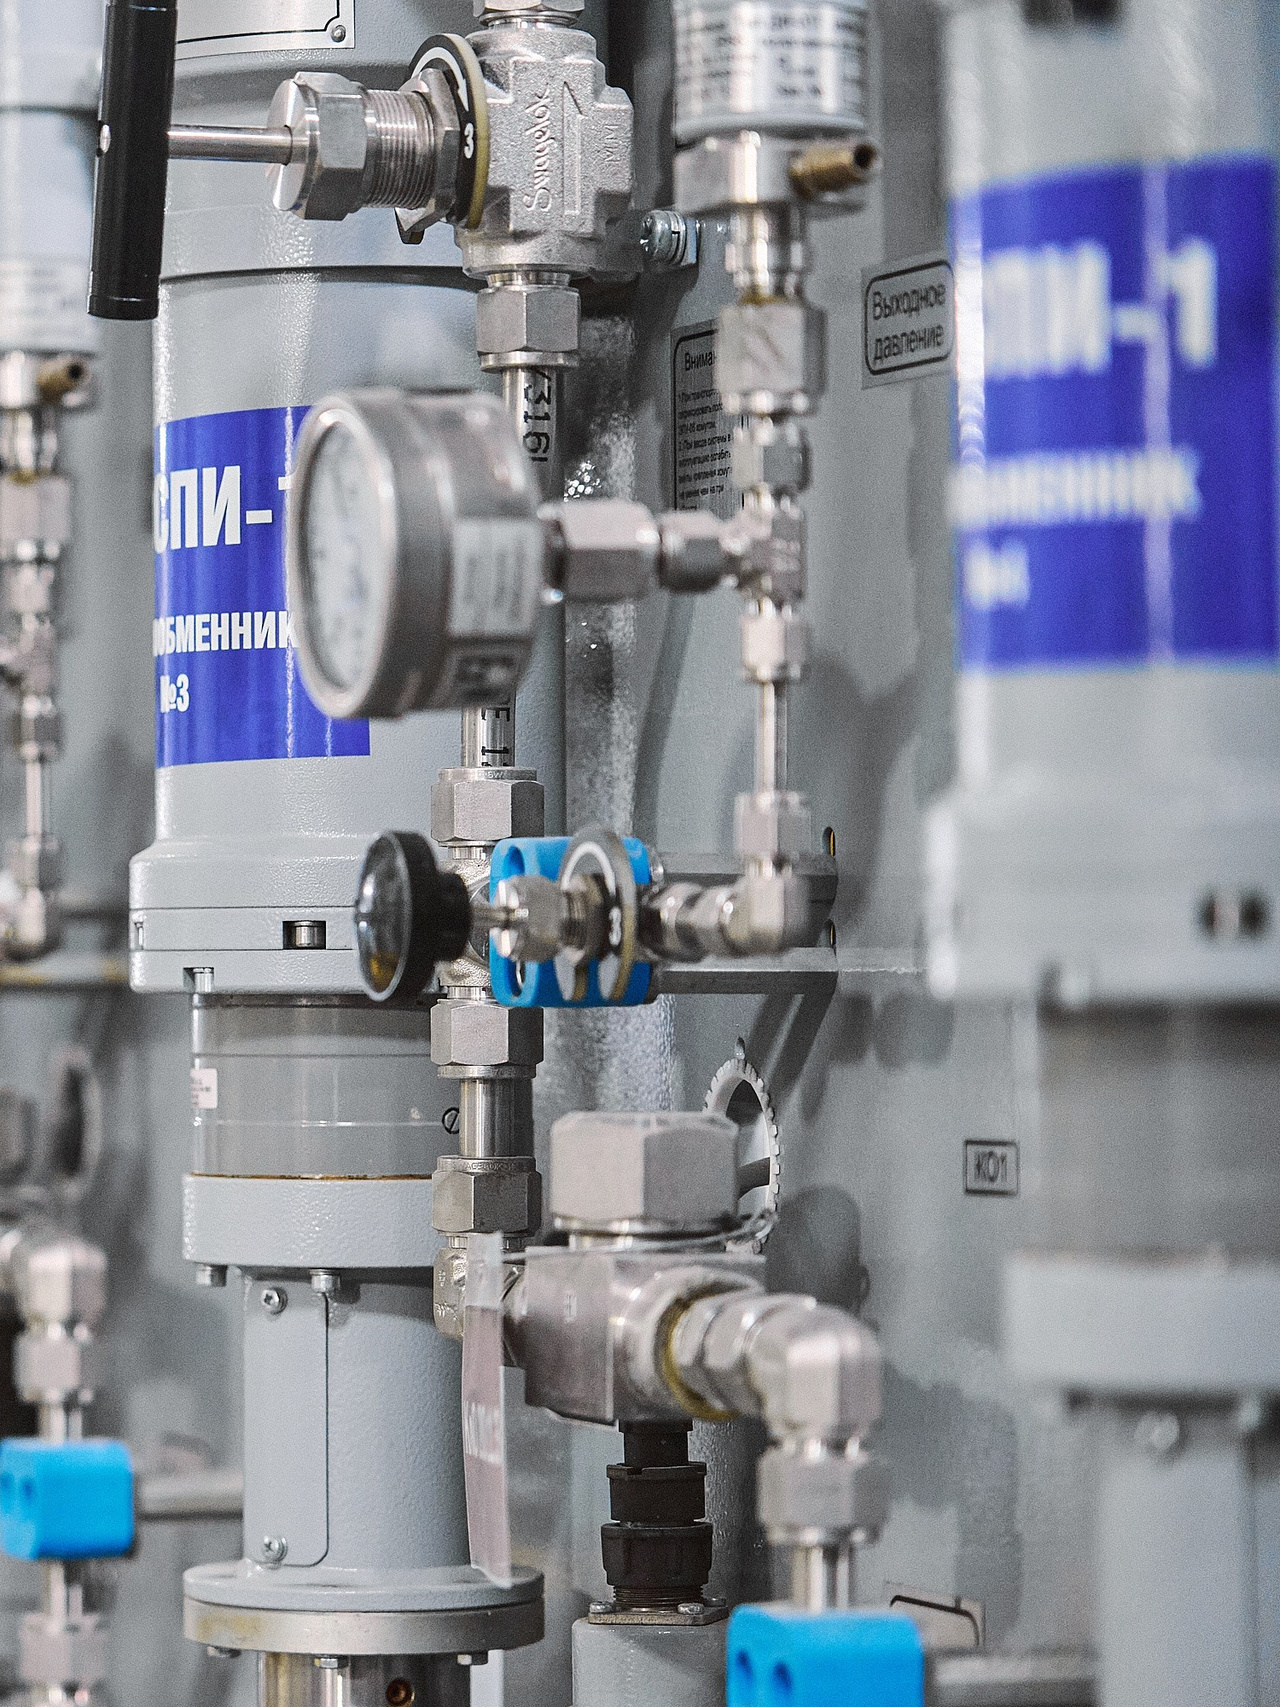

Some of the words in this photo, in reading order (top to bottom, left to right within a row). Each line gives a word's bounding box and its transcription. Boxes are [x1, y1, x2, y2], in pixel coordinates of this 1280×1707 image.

[523, 84, 557, 212] Swagelok
[872, 283, 946, 320] Выходное
[872, 325, 944, 366] давление
[154, 464, 295, 554] СПИ-
[159, 673, 190, 714] №3
